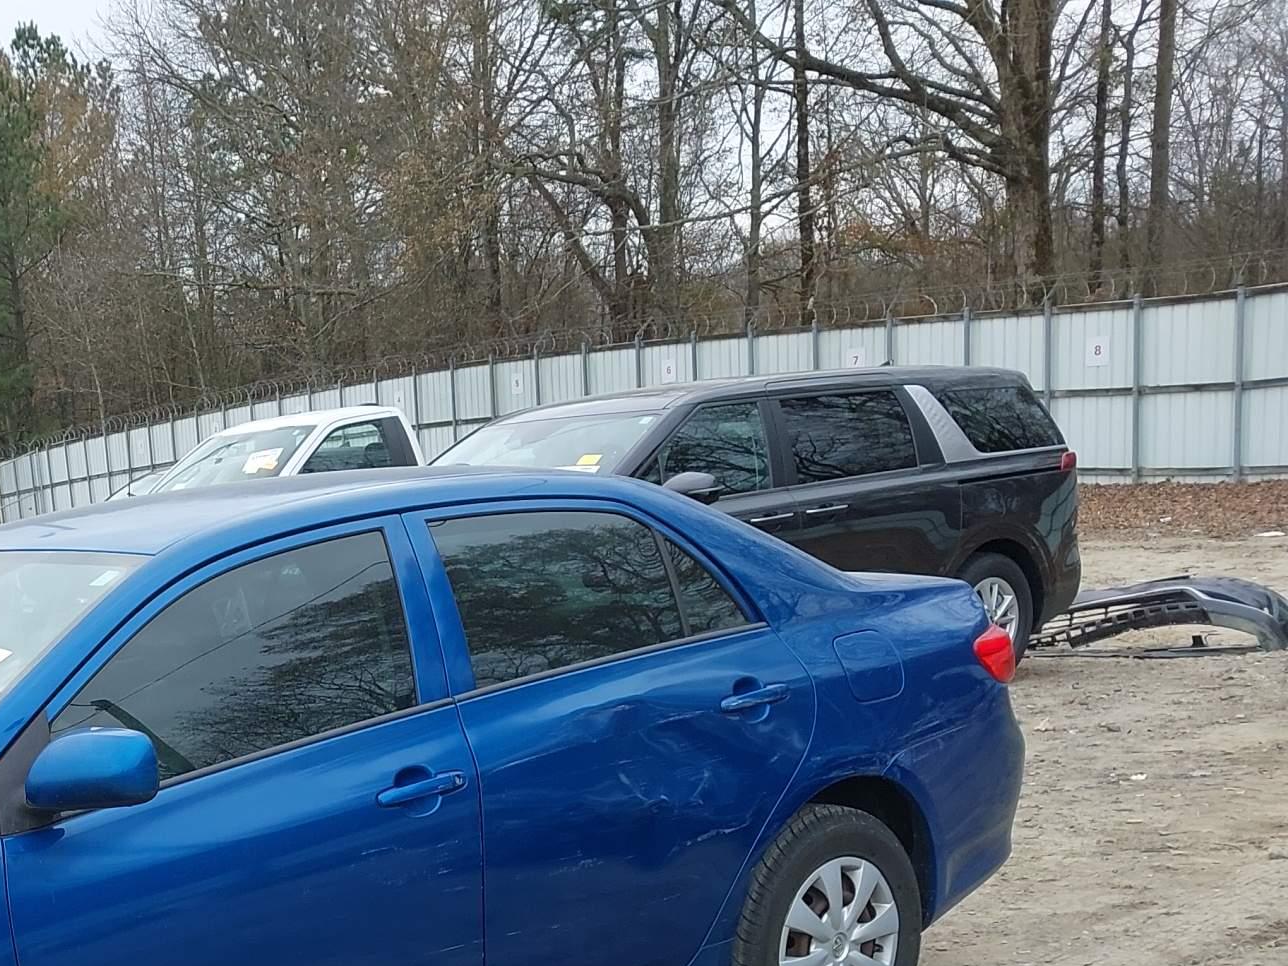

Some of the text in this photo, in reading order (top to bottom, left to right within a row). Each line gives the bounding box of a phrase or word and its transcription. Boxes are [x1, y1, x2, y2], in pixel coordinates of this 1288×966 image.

[1094, 345, 1102, 356] 8
[852, 355, 859, 365] 7
[666, 366, 672, 375] 6
